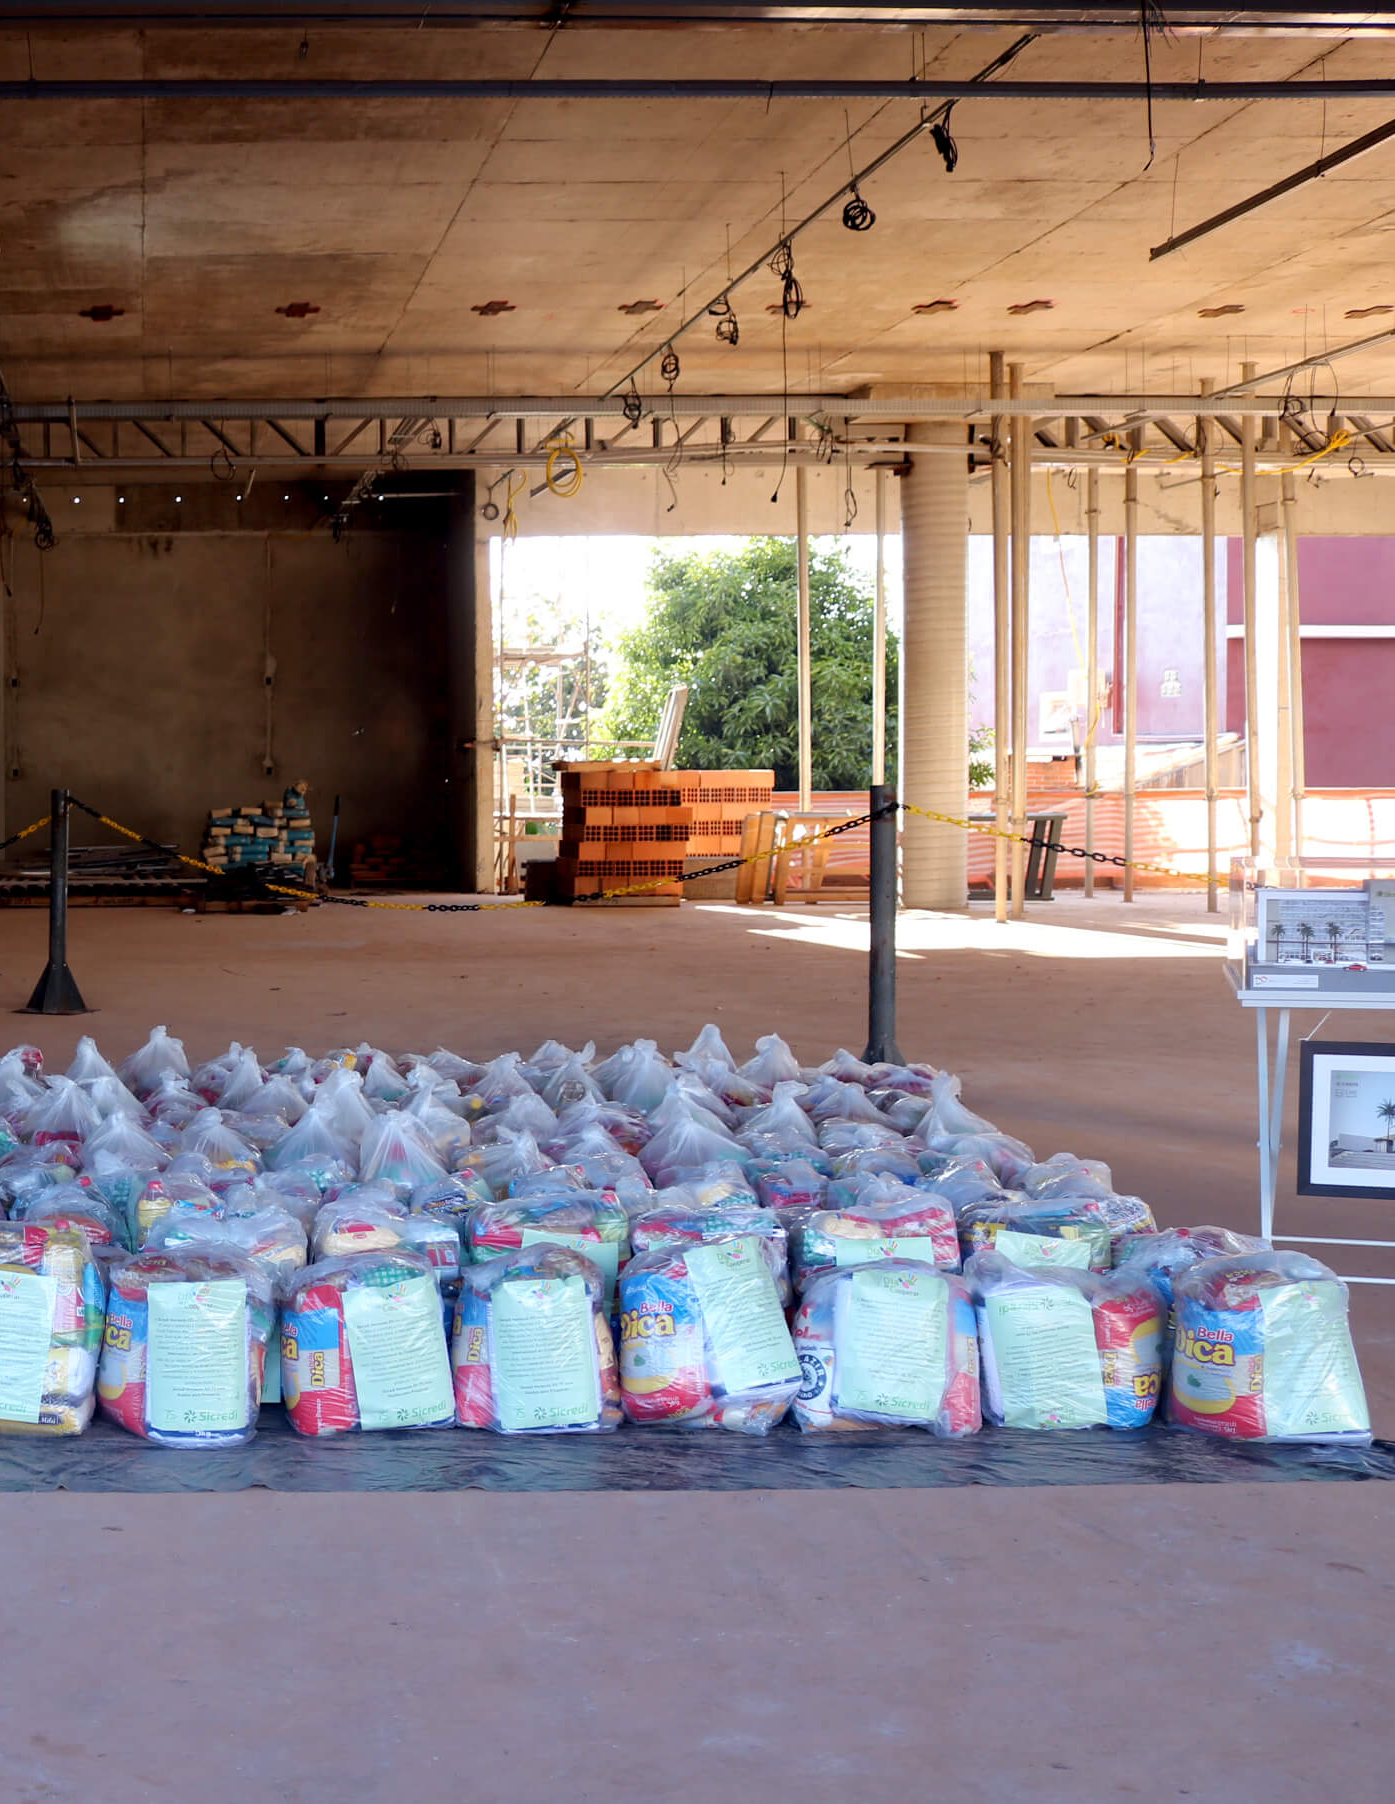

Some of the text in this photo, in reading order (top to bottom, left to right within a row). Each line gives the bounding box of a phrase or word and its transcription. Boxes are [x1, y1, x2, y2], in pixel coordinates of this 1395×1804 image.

[1197, 1325, 1235, 1343] Bella
[311, 1351, 326, 1387] Dica
[769, 1359, 798, 1373] Sicred
[198, 1408, 238, 1422] Sicredi
